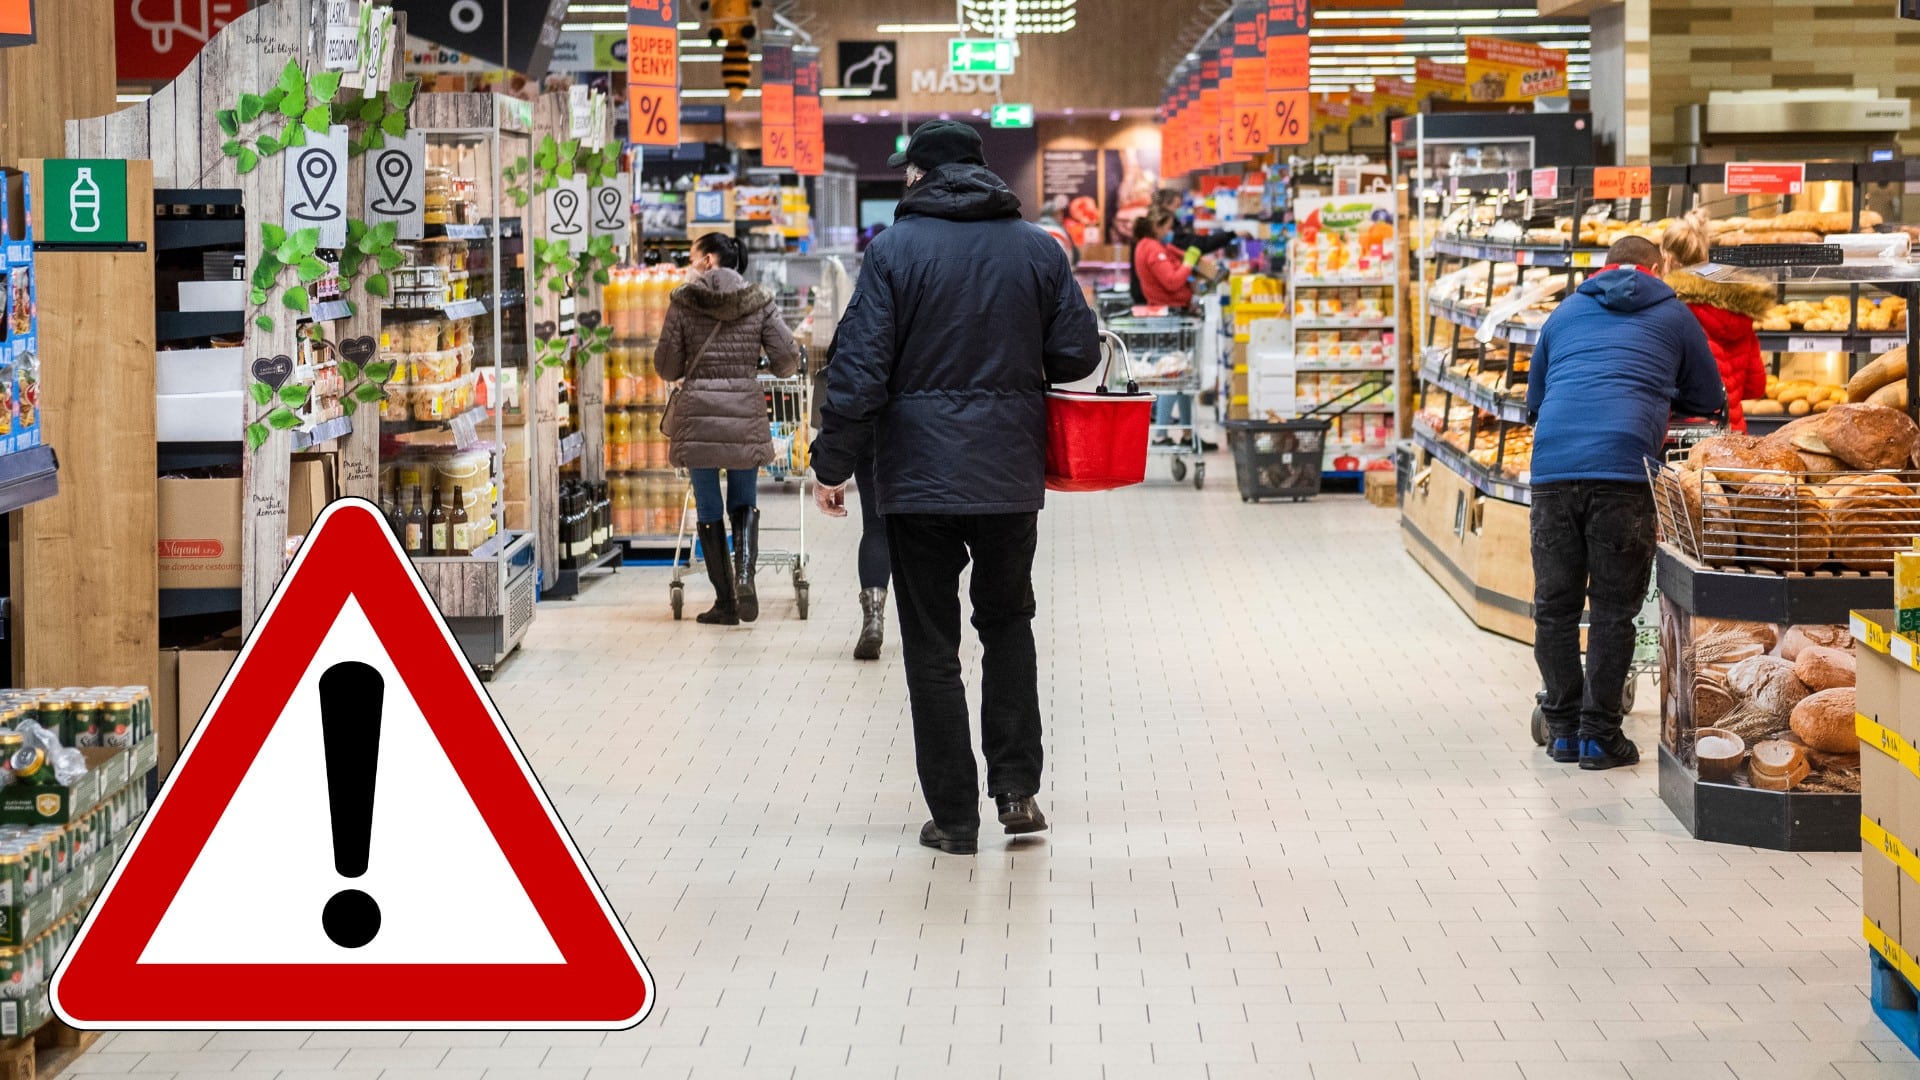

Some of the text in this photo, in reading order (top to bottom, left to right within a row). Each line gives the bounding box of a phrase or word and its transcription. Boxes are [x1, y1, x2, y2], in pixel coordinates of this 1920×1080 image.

[632, 36, 672, 55] SUPER
[632, 56, 673, 77] CENY!
[640, 95, 667, 136] %
